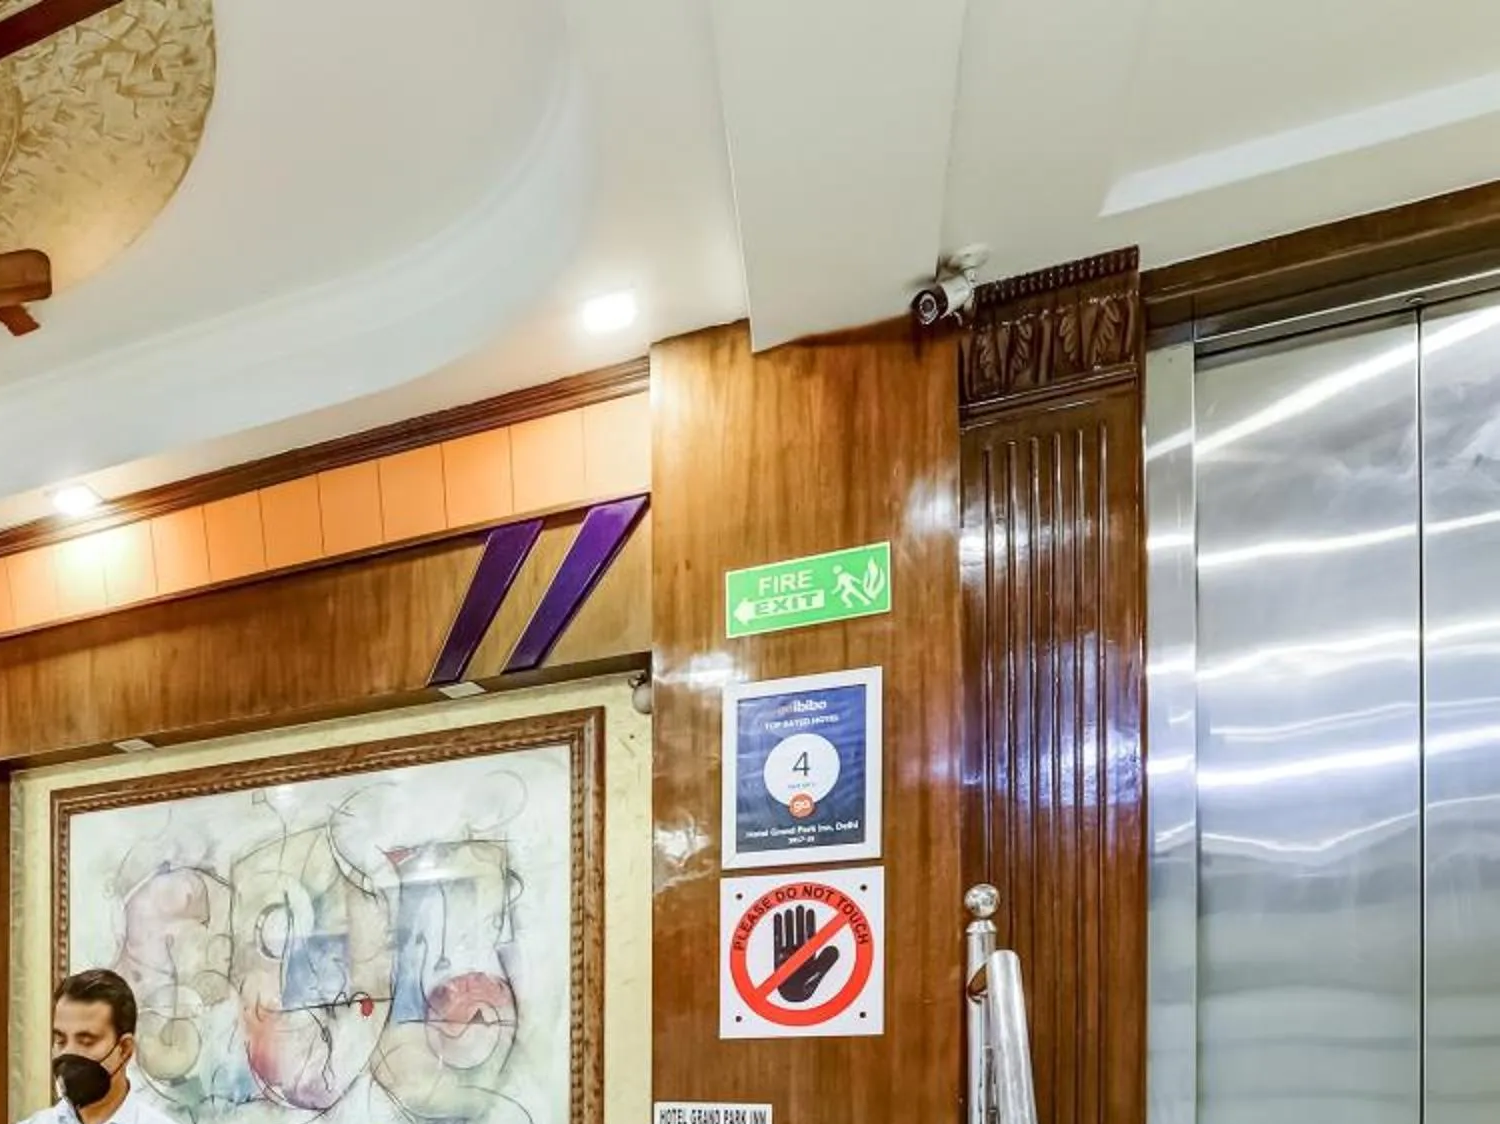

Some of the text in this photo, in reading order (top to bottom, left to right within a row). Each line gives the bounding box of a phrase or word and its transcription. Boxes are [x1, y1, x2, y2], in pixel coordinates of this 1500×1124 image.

[758, 569, 814, 596] FIRE
[755, 591, 817, 616] EXIT
[764, 714, 839, 730] TOP RATED HOTEL
[792, 752, 810, 776] 4
[770, 827, 795, 836] Grand
[797, 825, 817, 834] Park
[835, 820, 859, 831] Delhi
[733, 885, 870, 951] PLEASE DO NOT TOUCH
